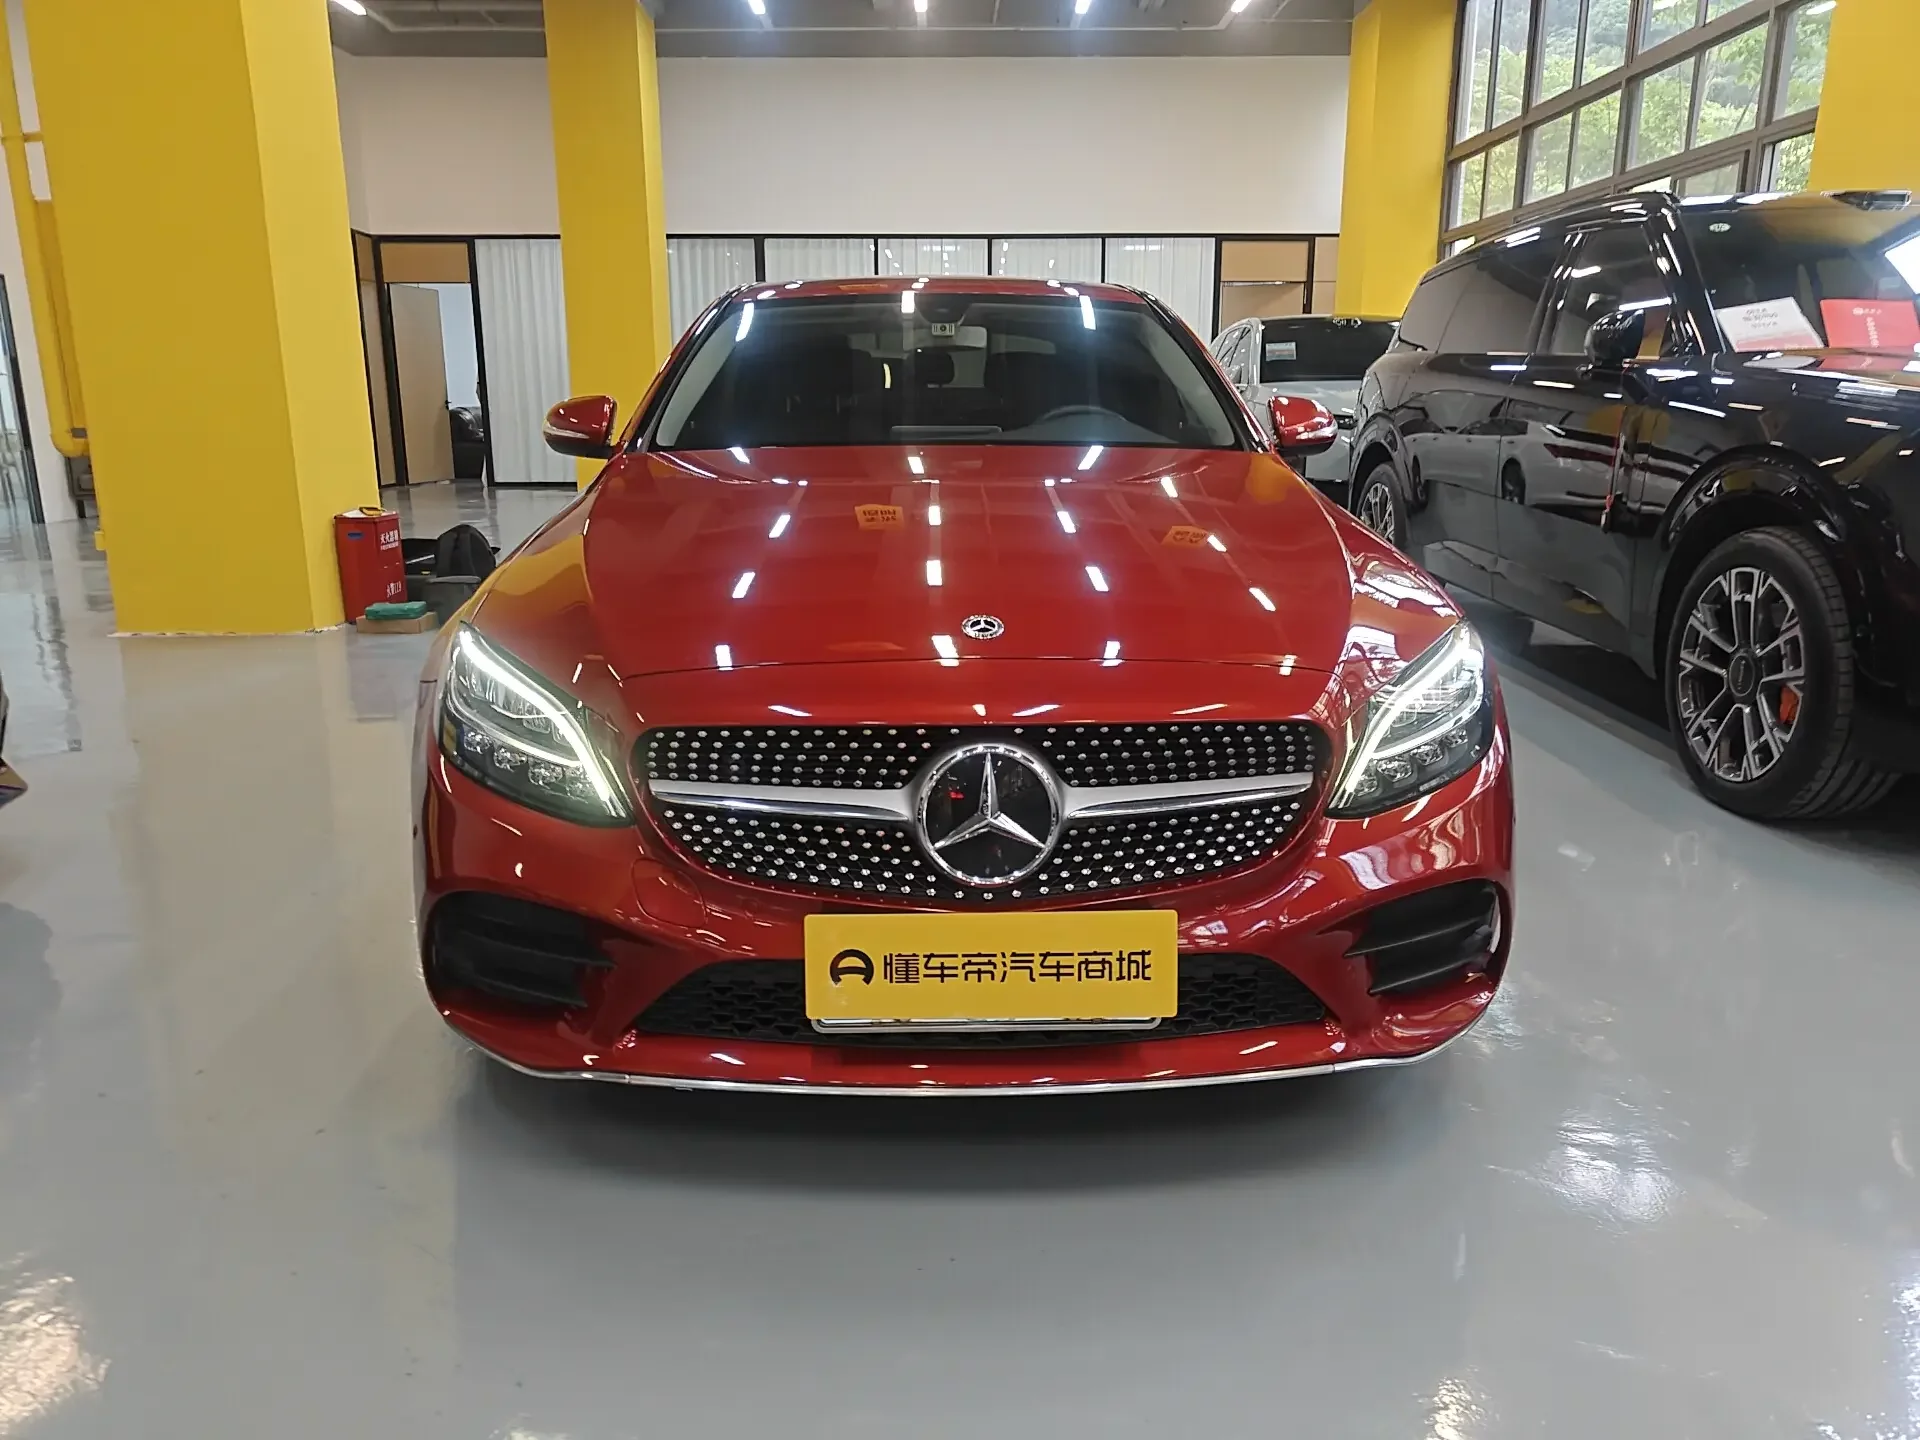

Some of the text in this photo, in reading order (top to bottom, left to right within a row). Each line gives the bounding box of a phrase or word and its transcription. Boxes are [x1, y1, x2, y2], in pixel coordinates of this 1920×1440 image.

[883, 949, 1152, 984] 懂车帝汽车商城
